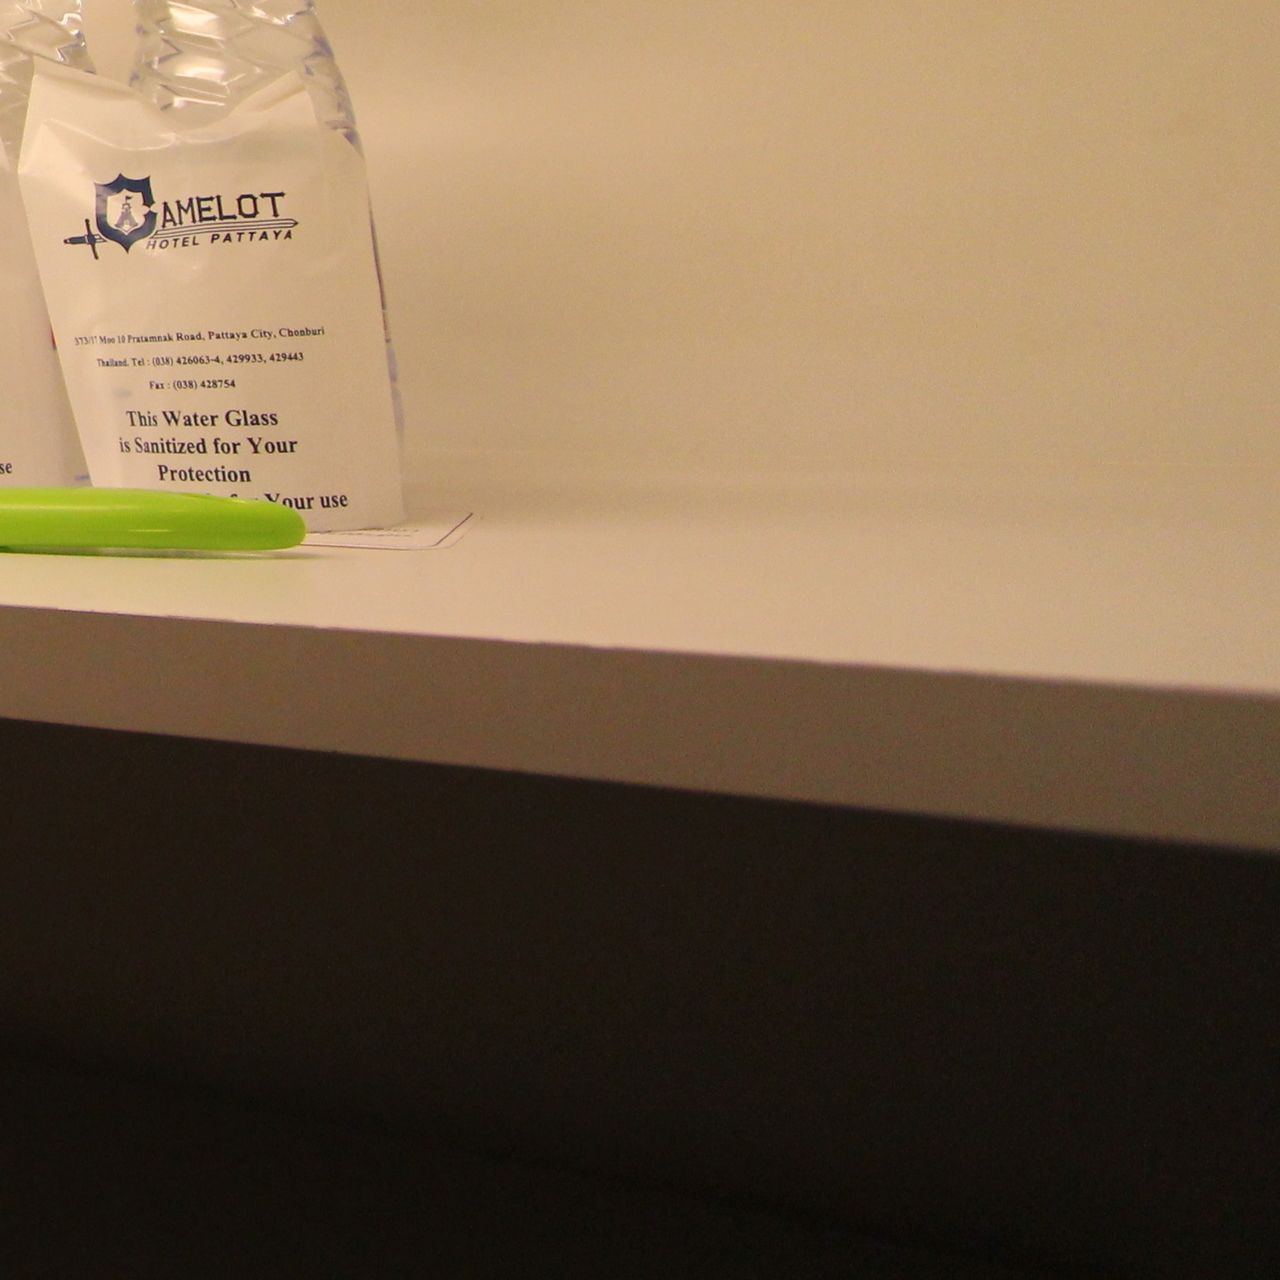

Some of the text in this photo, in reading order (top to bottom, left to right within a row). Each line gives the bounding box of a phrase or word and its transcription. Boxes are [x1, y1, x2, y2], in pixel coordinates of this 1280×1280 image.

[146, 230, 292, 250] HOTEL PATTAYA
[99, 335, 116, 345] Moo
[117, 334, 126, 344] 10
[127, 332, 174, 344] Pratamnak
[176, 331, 205, 342] Road,
[208, 330, 248, 342] Pattaya
[249, 328, 277, 340] City,
[278, 326, 325, 339] Chonburi
[132, 356, 146, 367] Tel
[152, 356, 174, 368] (038)
[175, 354, 225, 366] 426063-4,
[226, 353, 268, 365] 429933,
[269, 351, 305, 363] 429443
[149, 380, 165, 390] Fax
[173, 379, 198, 391] (038)
[200, 378, 236, 389] 428754
[126, 409, 279, 427] This Water Glass
[119, 436, 298, 454] is Sanitized for Your
[158, 464, 252, 483] Protection
[319, 493, 350, 509] use
